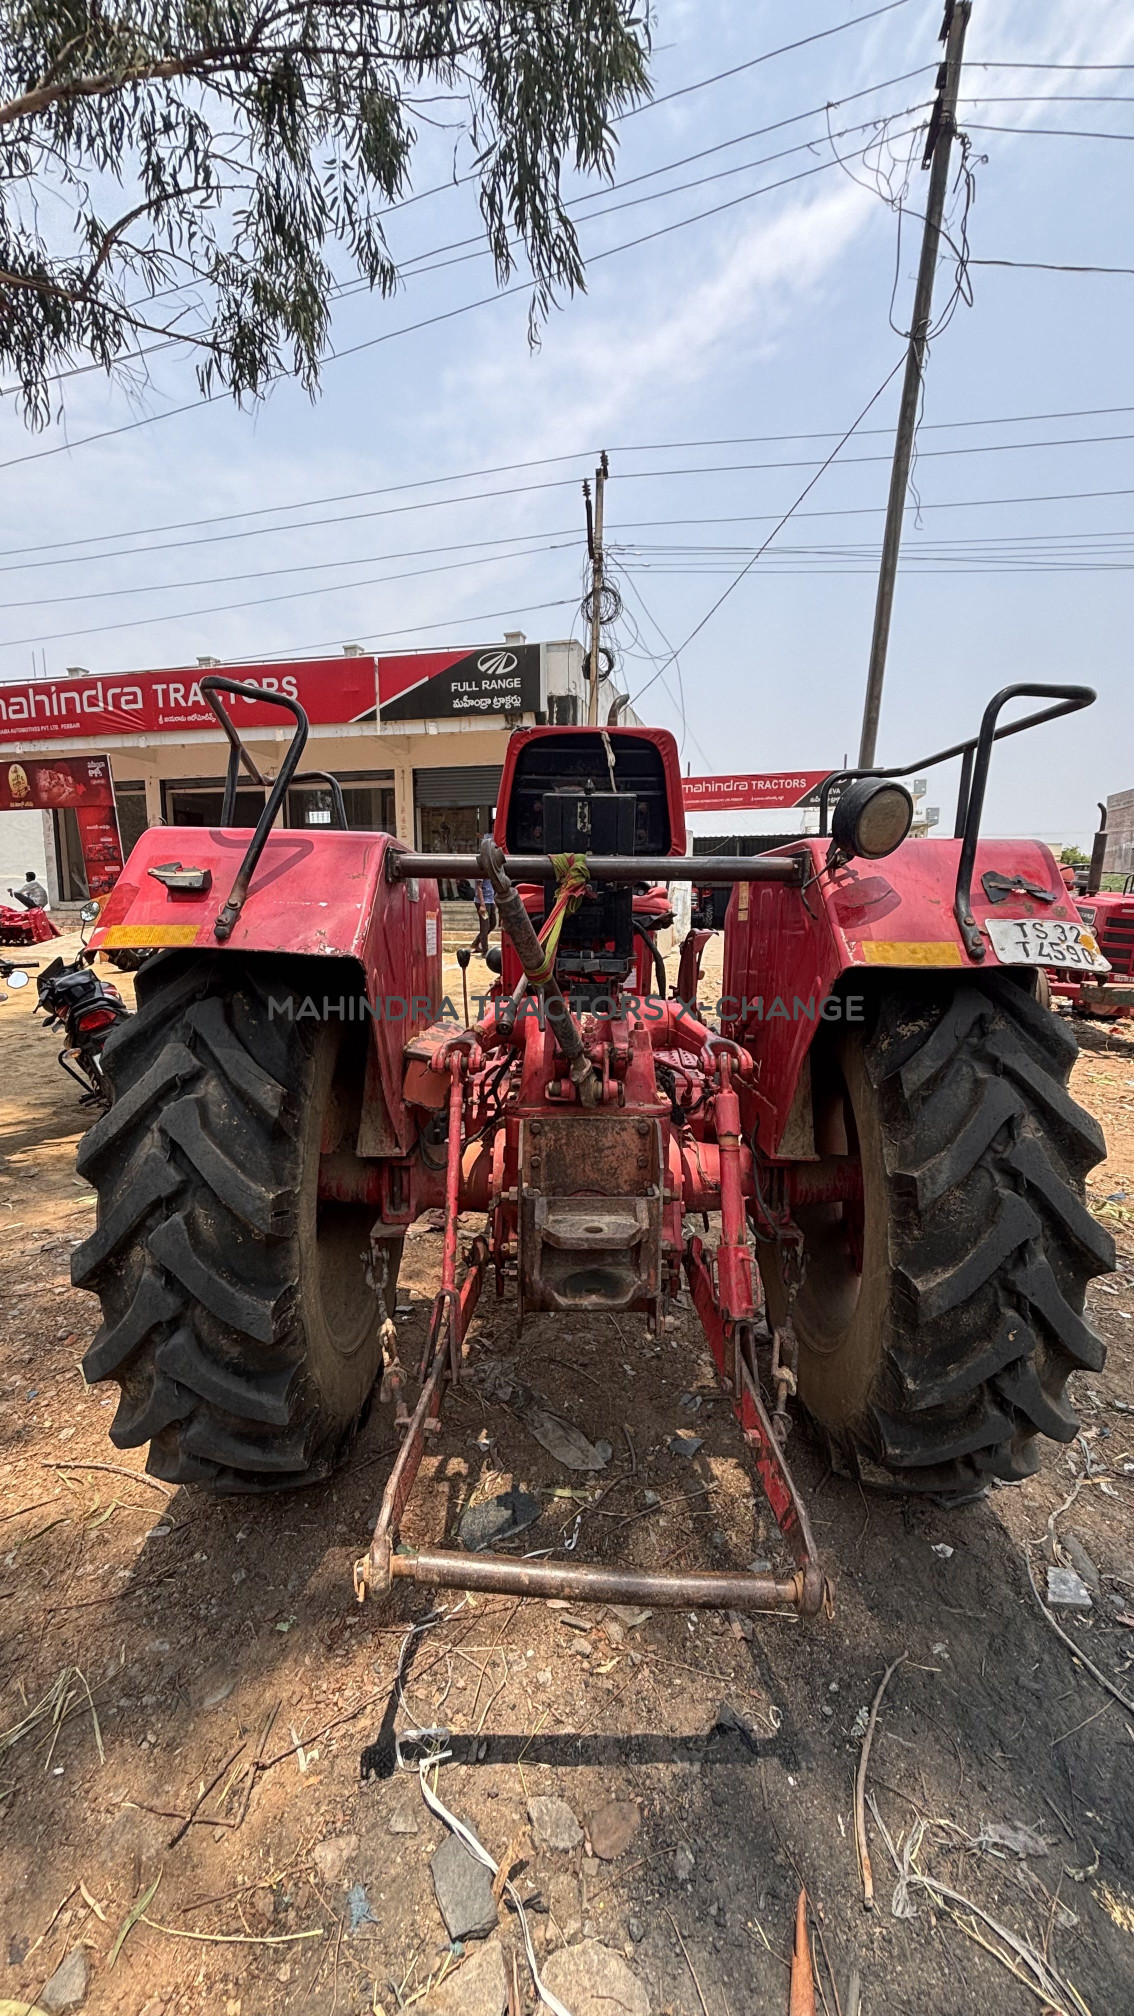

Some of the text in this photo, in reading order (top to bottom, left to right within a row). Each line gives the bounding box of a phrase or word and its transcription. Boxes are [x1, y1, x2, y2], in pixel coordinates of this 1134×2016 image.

[451, 678, 521, 692] FULL RANGE
[0, 676, 298, 720] ahindra TRAORS
[10, 725, 40, 734] AUTOMOTIVES
[682, 779, 807, 793] mahindra TRACTORS
